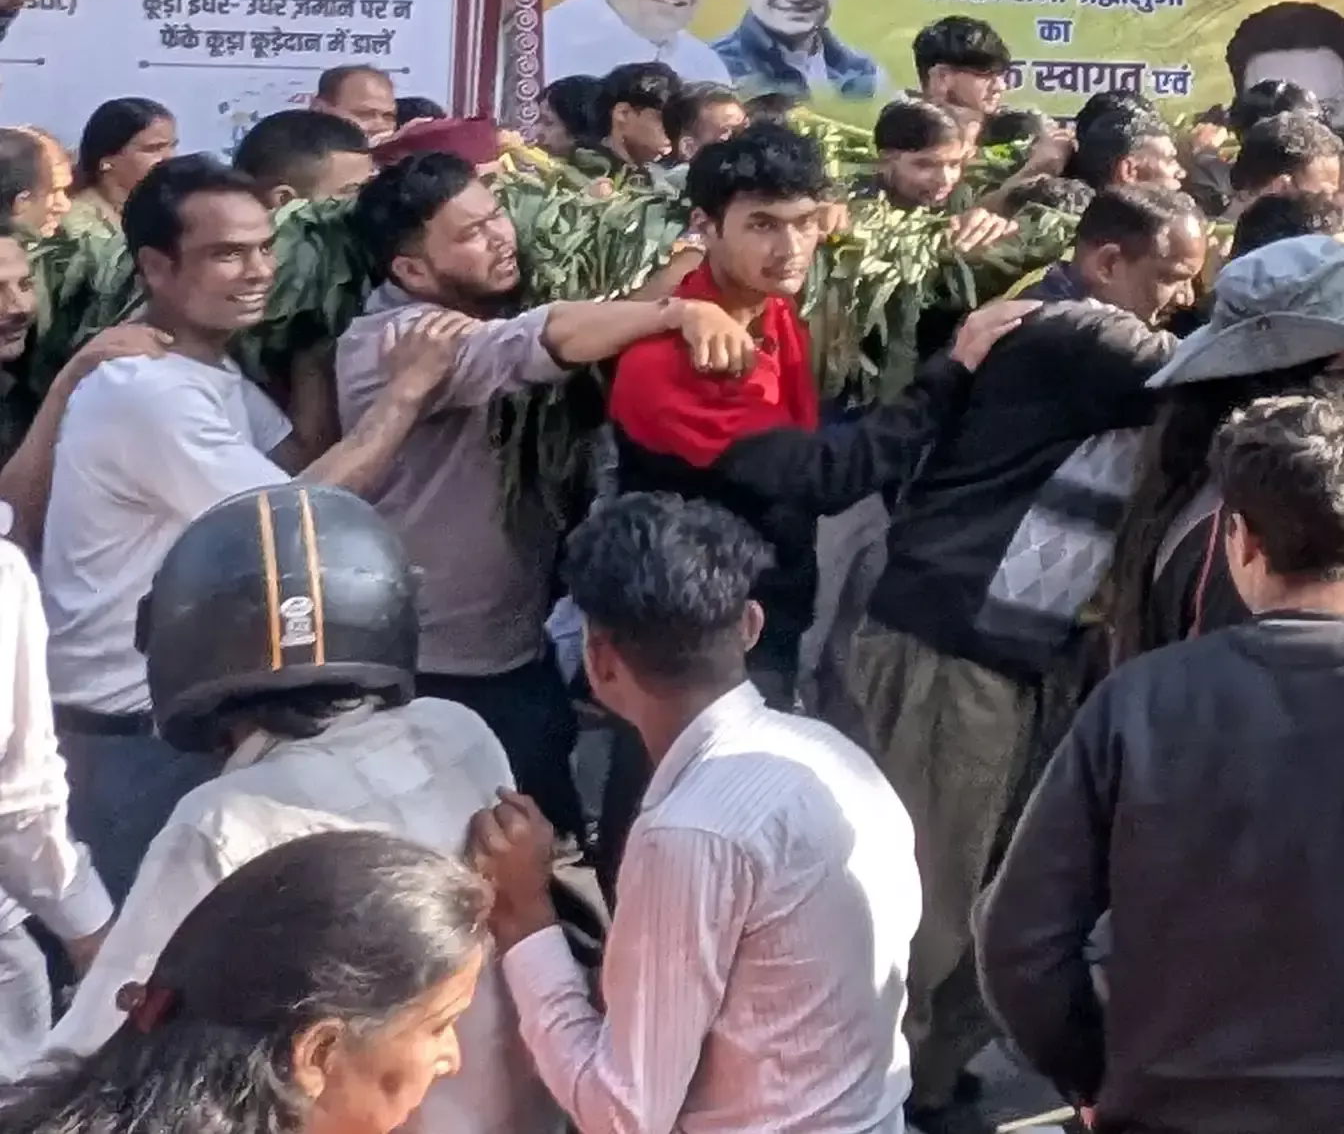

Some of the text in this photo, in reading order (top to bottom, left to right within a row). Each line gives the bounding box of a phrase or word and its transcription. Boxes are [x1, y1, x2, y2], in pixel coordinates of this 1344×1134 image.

[391, 0, 413, 20] न
[1036, 18, 1072, 43] का
[1031, 60, 1146, 93] स्वागत
[1151, 63, 1192, 96] एवं
